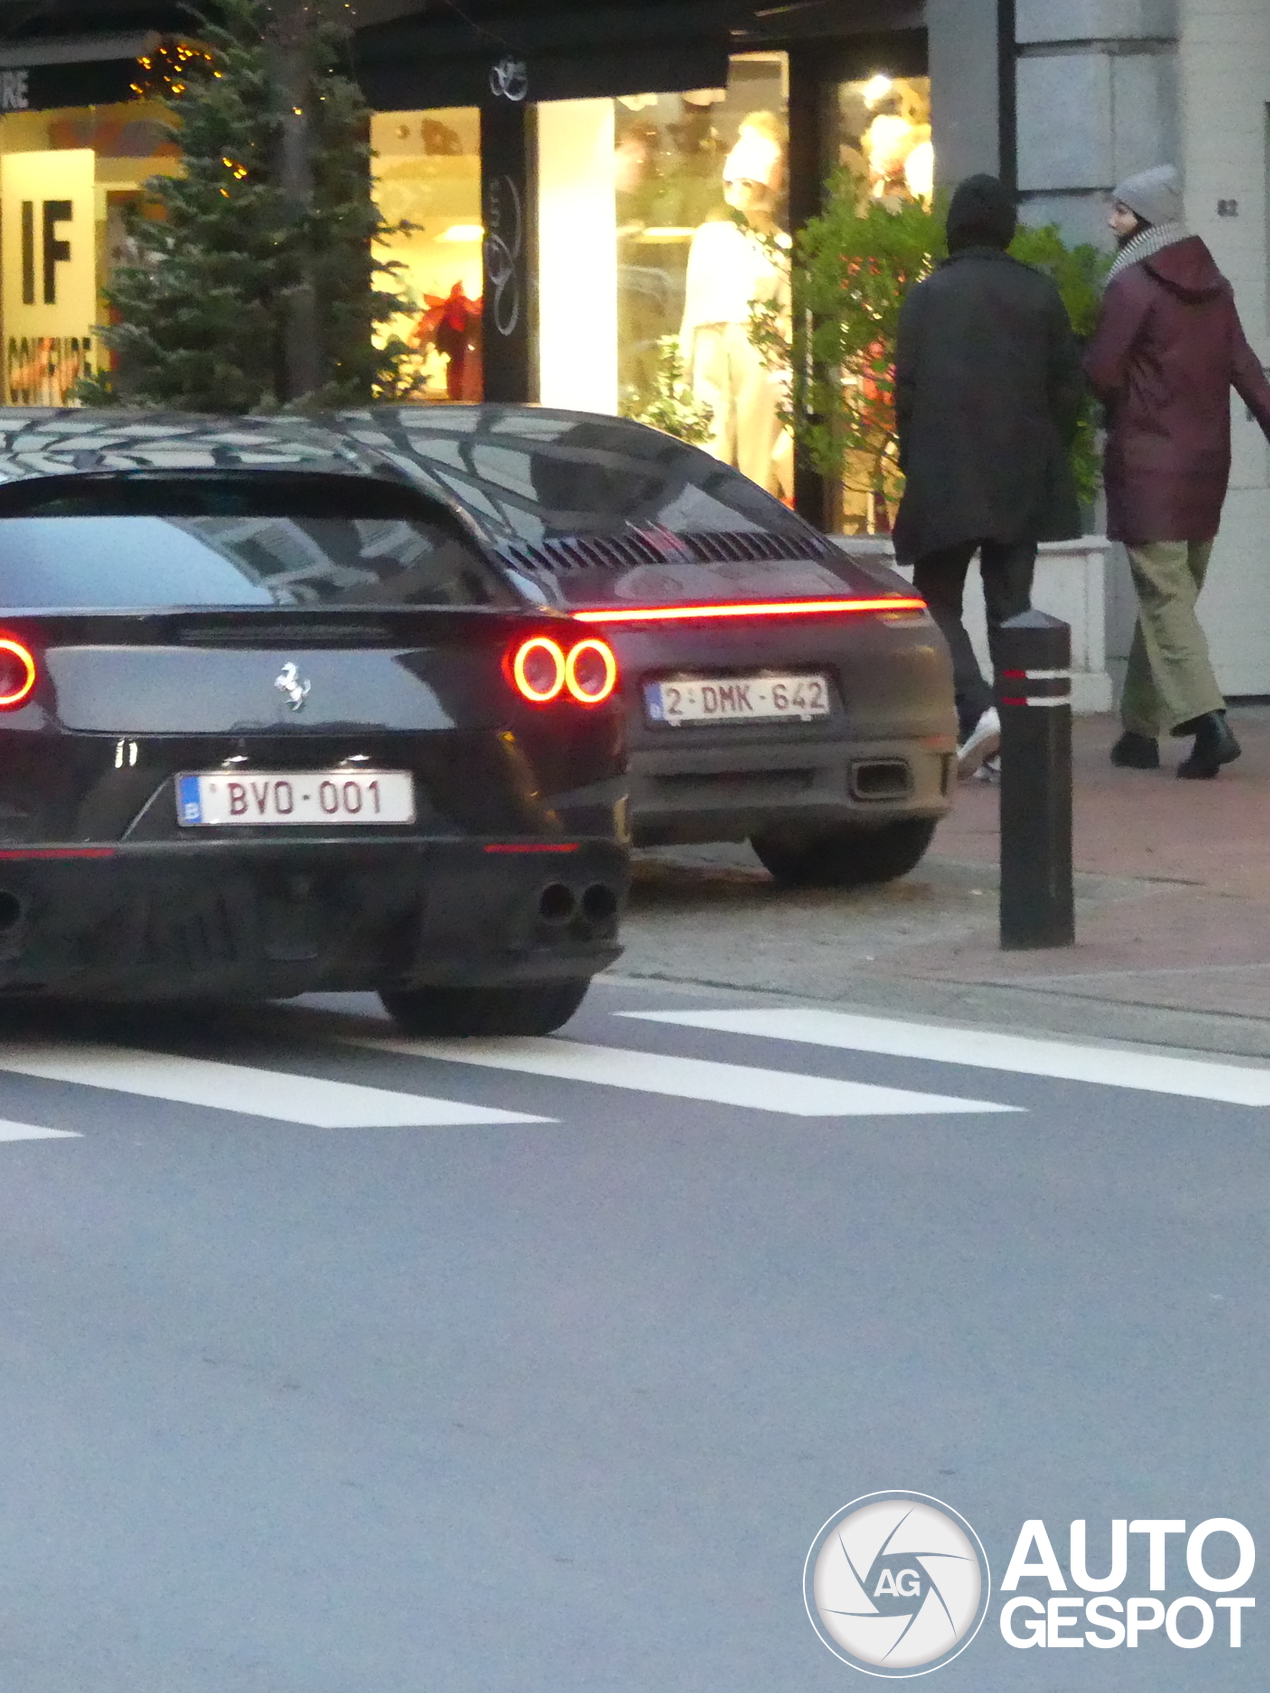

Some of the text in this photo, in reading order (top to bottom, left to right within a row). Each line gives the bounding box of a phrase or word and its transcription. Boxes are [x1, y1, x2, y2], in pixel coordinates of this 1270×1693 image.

[22, 200, 72, 304] IF
[667, 682, 826, 715] 2-DMK-642
[227, 780, 381, 815] BVO-001
